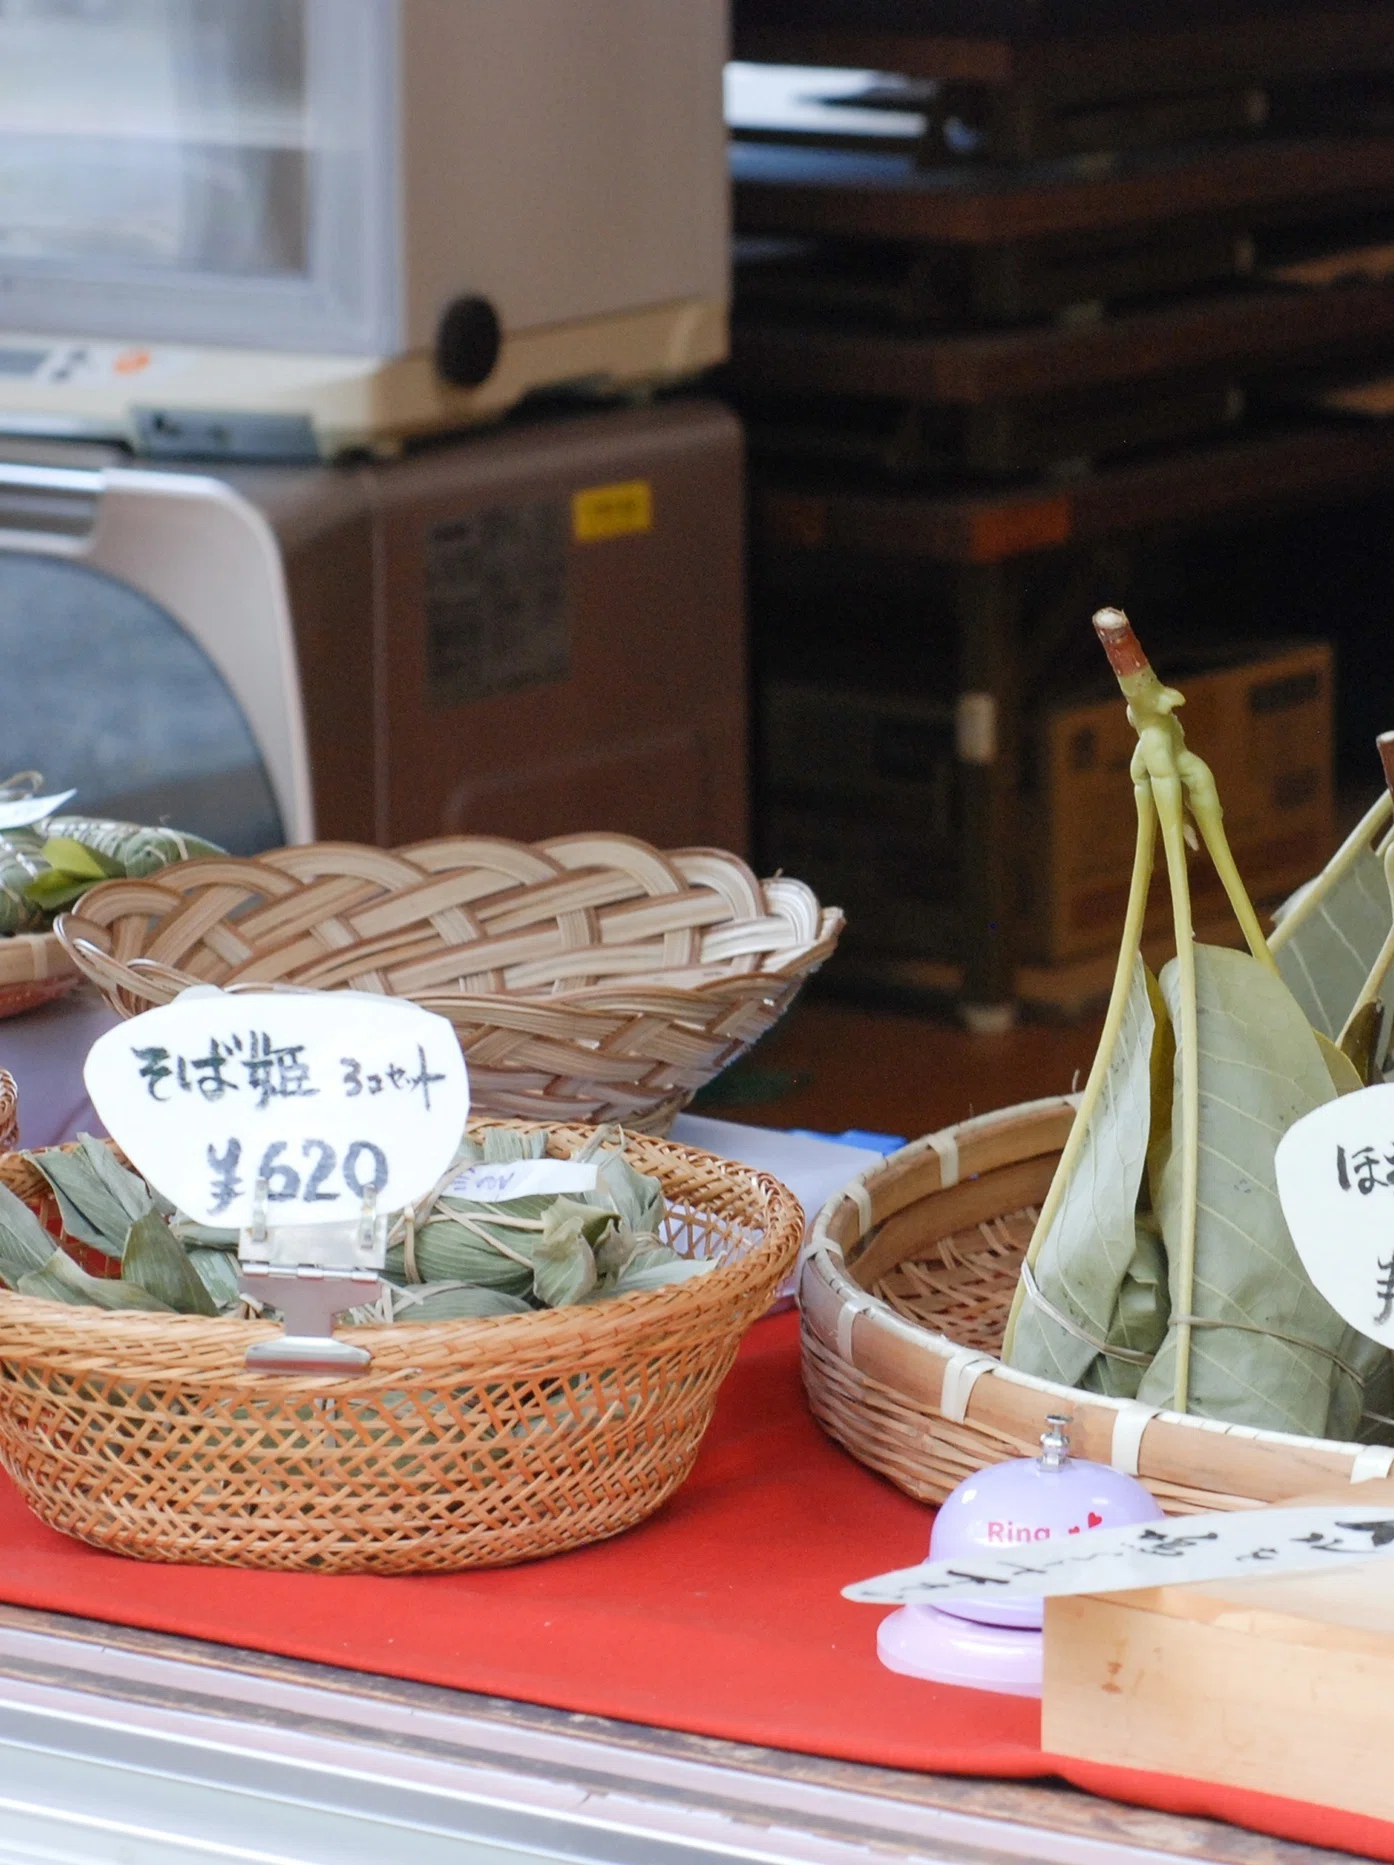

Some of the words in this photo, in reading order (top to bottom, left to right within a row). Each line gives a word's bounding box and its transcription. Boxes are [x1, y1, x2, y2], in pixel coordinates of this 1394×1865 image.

[130, 1029, 321, 1110] そば姫
[206, 1136, 389, 1216] ¥620
